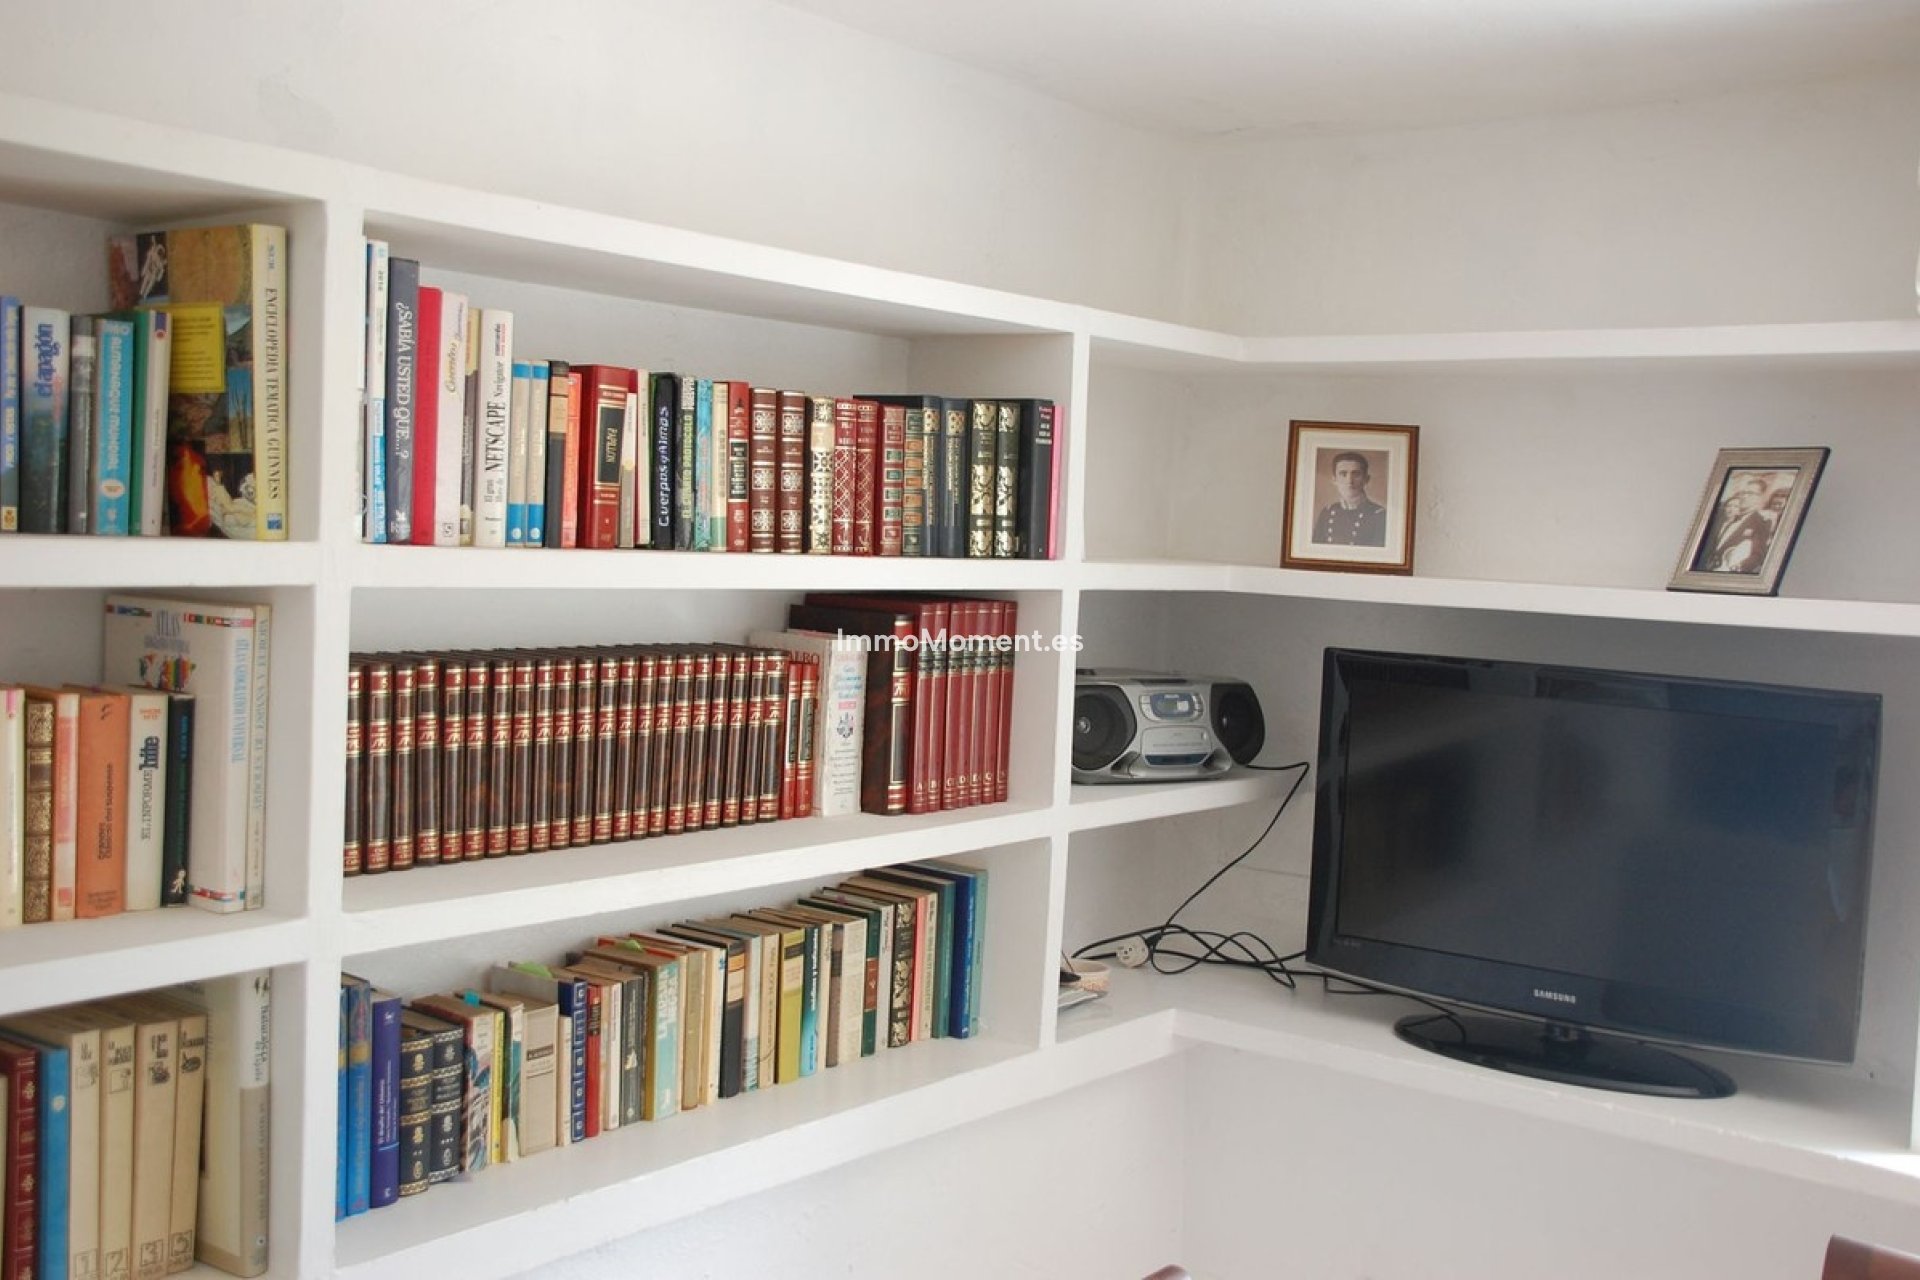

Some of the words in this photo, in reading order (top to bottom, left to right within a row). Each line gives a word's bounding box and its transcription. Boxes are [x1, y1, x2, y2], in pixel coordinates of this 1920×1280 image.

[265, 288, 279, 376] ENCICLOPEDIA
[395, 355, 411, 405] USTED
[266, 377, 281, 435] TEMATICA
[659, 405, 669, 455] Almas
[484, 400, 506, 473] NETSCAPE
[660, 455, 669, 464] y
[682, 414, 693, 468] PROTOCOLO
[267, 437, 282, 501] GUINNESS
[657, 464, 671, 528] Cuerpos
[427, 671, 435, 681] 7
[138, 735, 159, 771] hite
[142, 769, 153, 825] INFORME
[958, 774, 966, 784] D
[1532, 988, 1577, 1005] SAMSUNG
[110, 1253, 126, 1273] 2
[145, 1245, 159, 1264] 3
